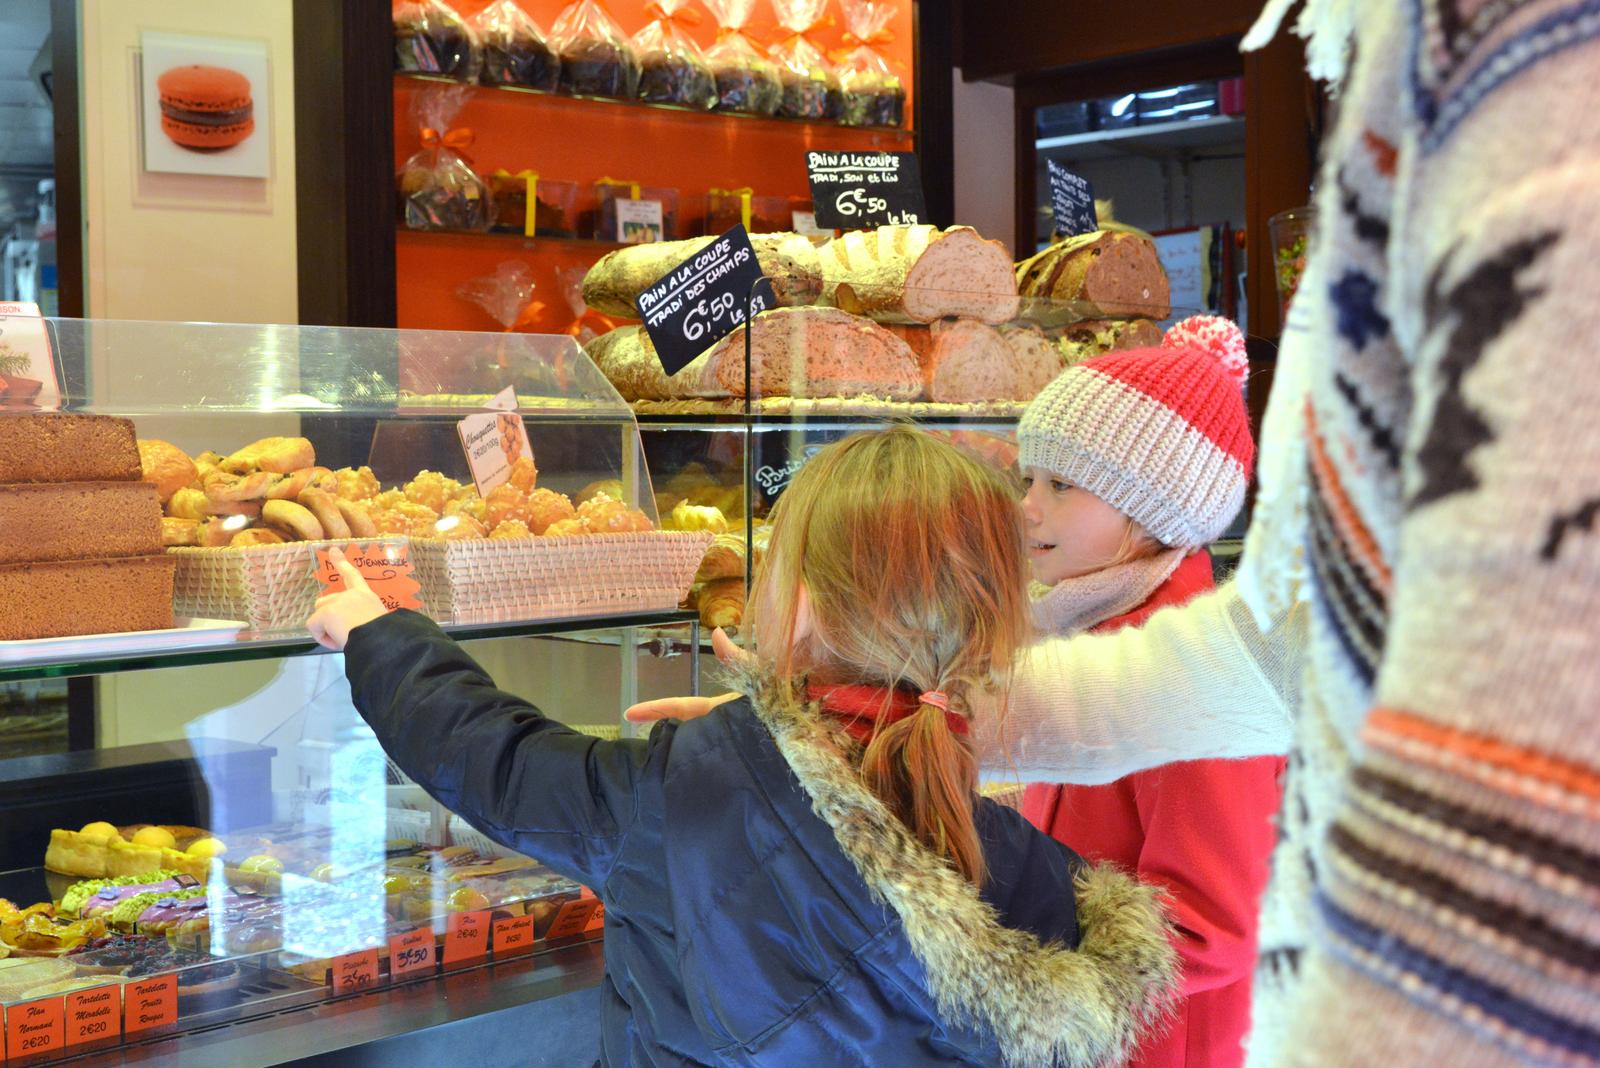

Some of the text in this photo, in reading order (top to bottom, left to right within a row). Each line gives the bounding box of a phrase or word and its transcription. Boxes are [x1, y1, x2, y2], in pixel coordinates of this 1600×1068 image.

[808, 152, 900, 169] PAIN A LA COUPE
[844, 173, 863, 182] SON
[868, 173, 881, 183] et
[639, 239, 731, 312] PAIN A LA COUPE
[685, 279, 705, 301] DES
[706, 247, 750, 284] CHAMPS
[77, 992, 111, 1006] Tartelette
[140, 999, 163, 1011] Fruits
[27, 1007, 45, 1019] Flan
[75, 1007, 112, 1021] Mirabelle
[139, 1012, 164, 1024] Rouges
[19, 1020, 53, 1034] Normand
[80, 1021, 107, 1036] 2€20
[22, 1034, 50, 1050] 2€20
